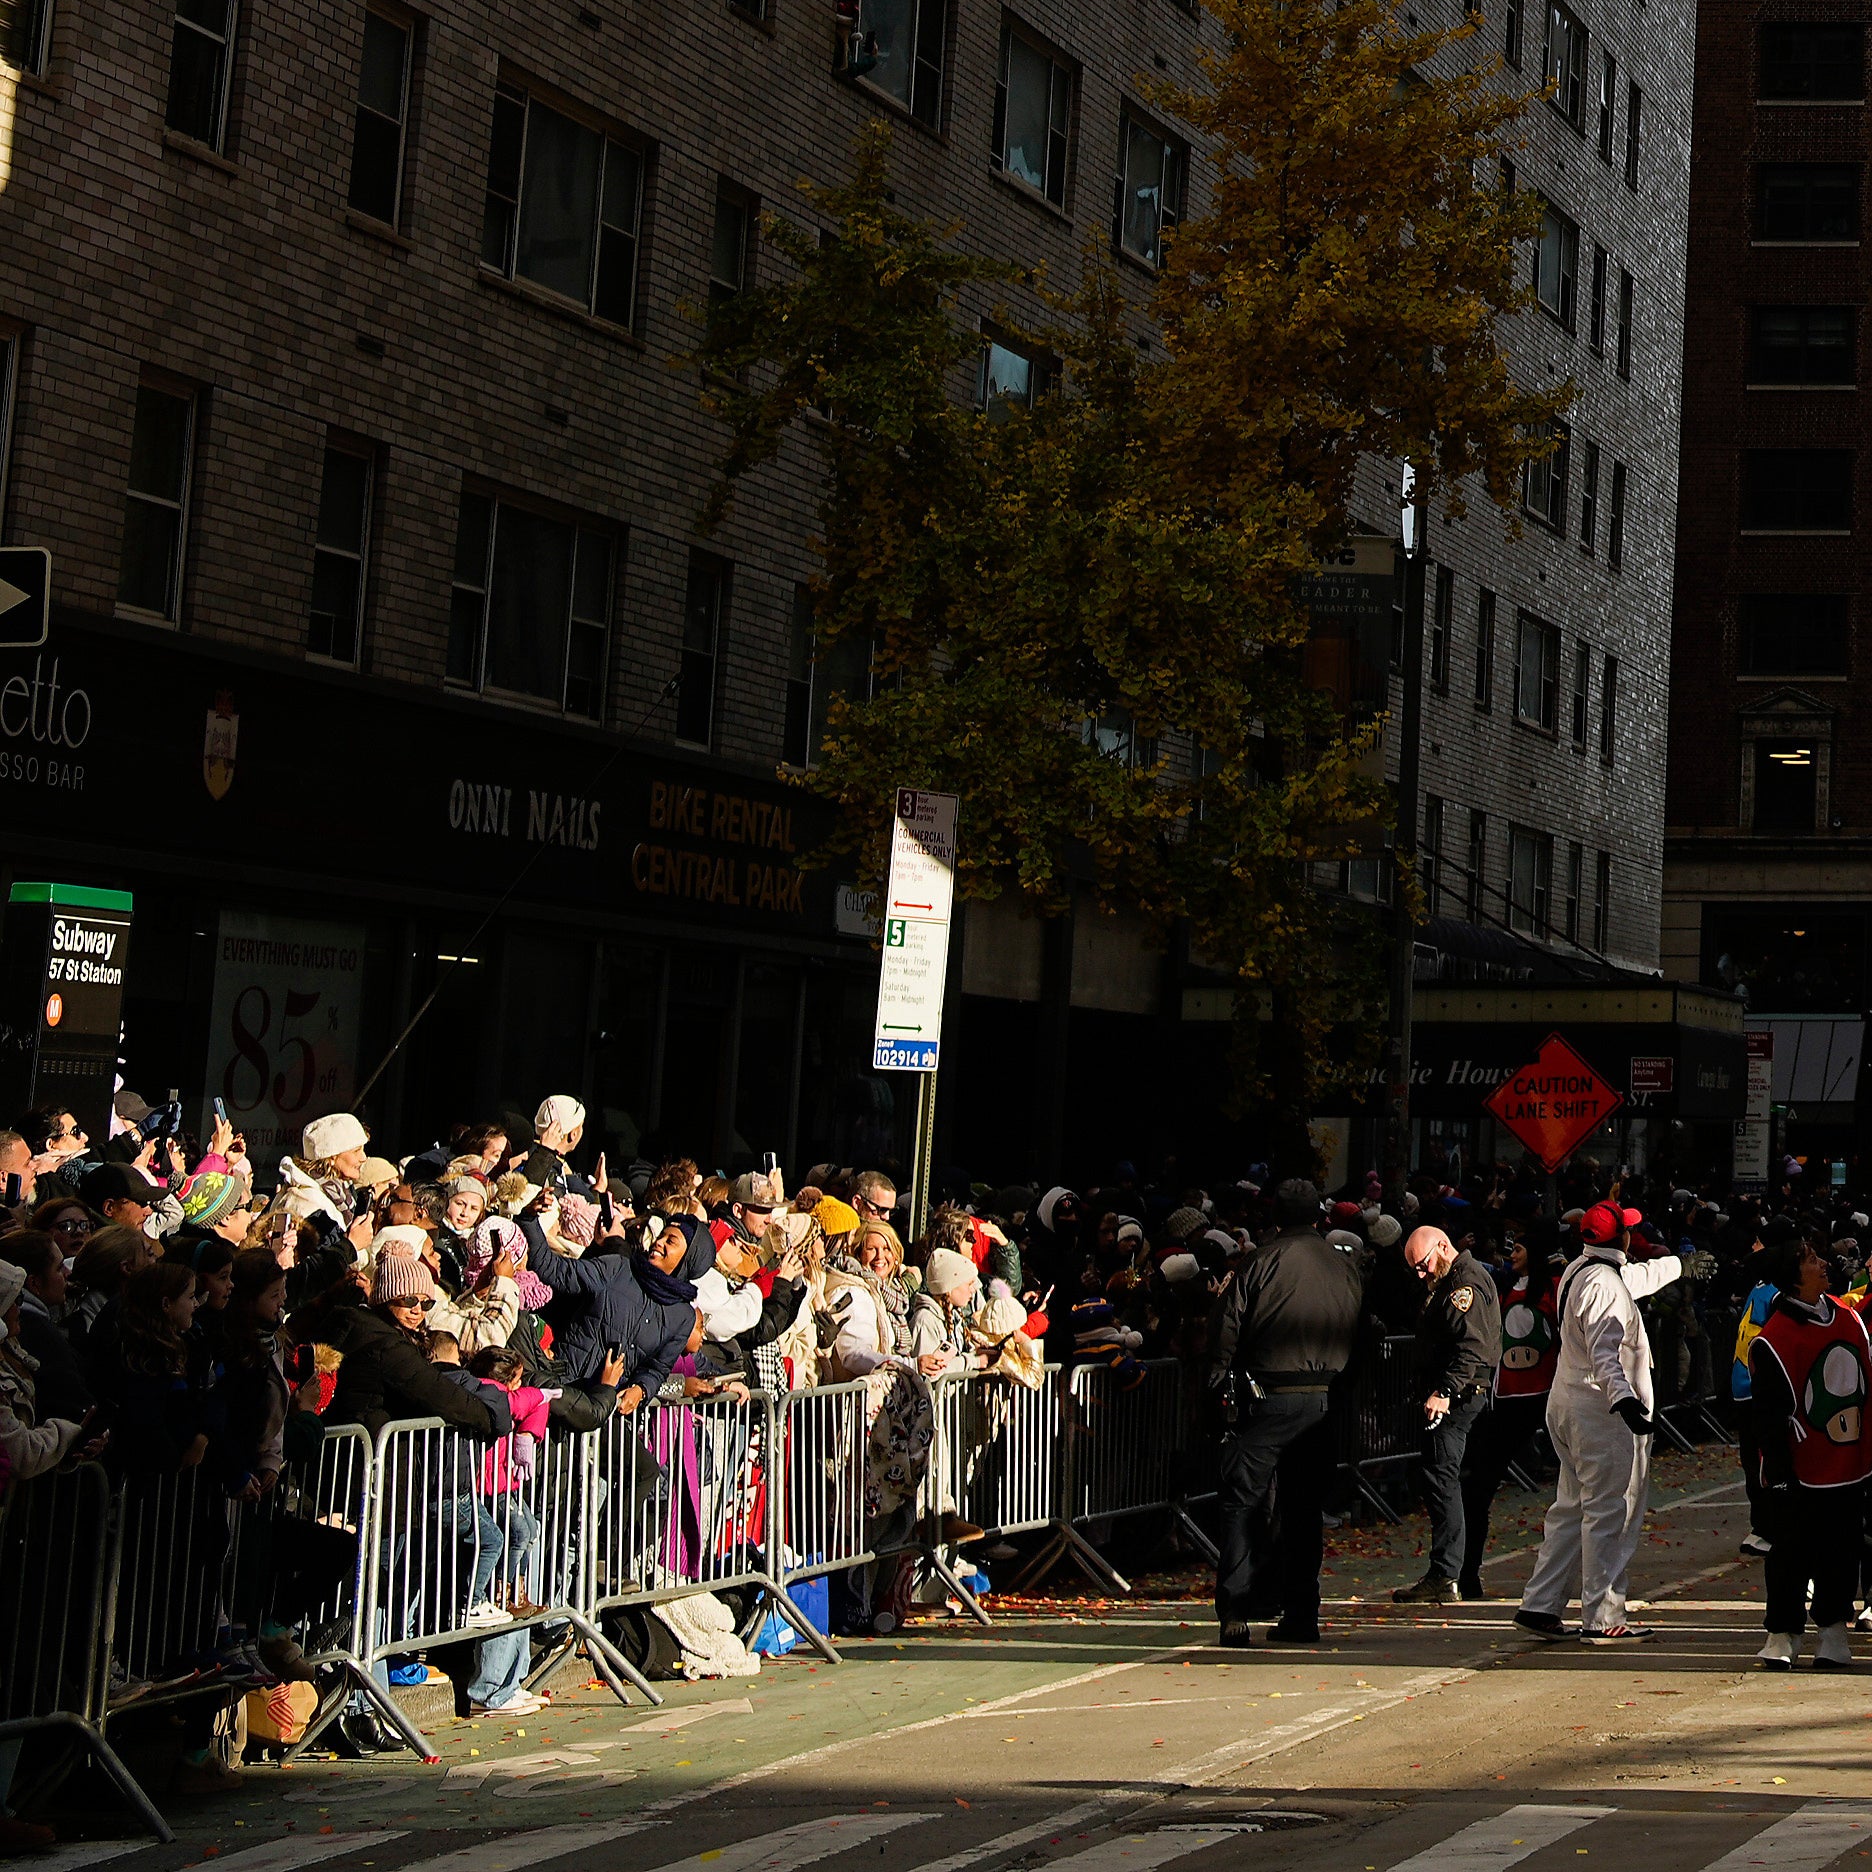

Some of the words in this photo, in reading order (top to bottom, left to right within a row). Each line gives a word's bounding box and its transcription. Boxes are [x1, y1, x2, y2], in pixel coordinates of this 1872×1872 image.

[1300, 587, 1370, 598] EADER
[0, 654, 91, 748] etto
[47, 760, 85, 791] BAR
[449, 778, 513, 837] ONNI
[526, 789, 601, 851] NAILS
[650, 779, 708, 837] BIKE
[710, 792, 797, 853] RENTAL
[903, 793, 913, 817] 3
[898, 828, 945, 844] COMMERCIAL
[897, 842, 931, 856] VEHICLES
[932, 846, 952, 859] ONLY
[631, 842, 741, 905] CENTRAL
[744, 863, 807, 916] PARK
[52, 919, 117, 961] Subway
[890, 920, 903, 946] 5
[223, 937, 300, 966] EVERYTHING
[302, 944, 337, 969] MUST
[340, 948, 357, 971] GO
[48, 957, 65, 980] 57
[65, 958, 80, 981] St
[80, 959, 122, 985] Station
[49, 999, 60, 1018] M
[328, 1007, 338, 1030] %
[223, 985, 321, 1113] 85
[876, 1049, 919, 1067] 102914
[319, 1066, 338, 1093] off
[1445, 1059, 1514, 1085] Hous
[1513, 1076, 1593, 1095] CAUTION
[1505, 1100, 1548, 1120] LANE
[1553, 1100, 1601, 1118] SHIFT
